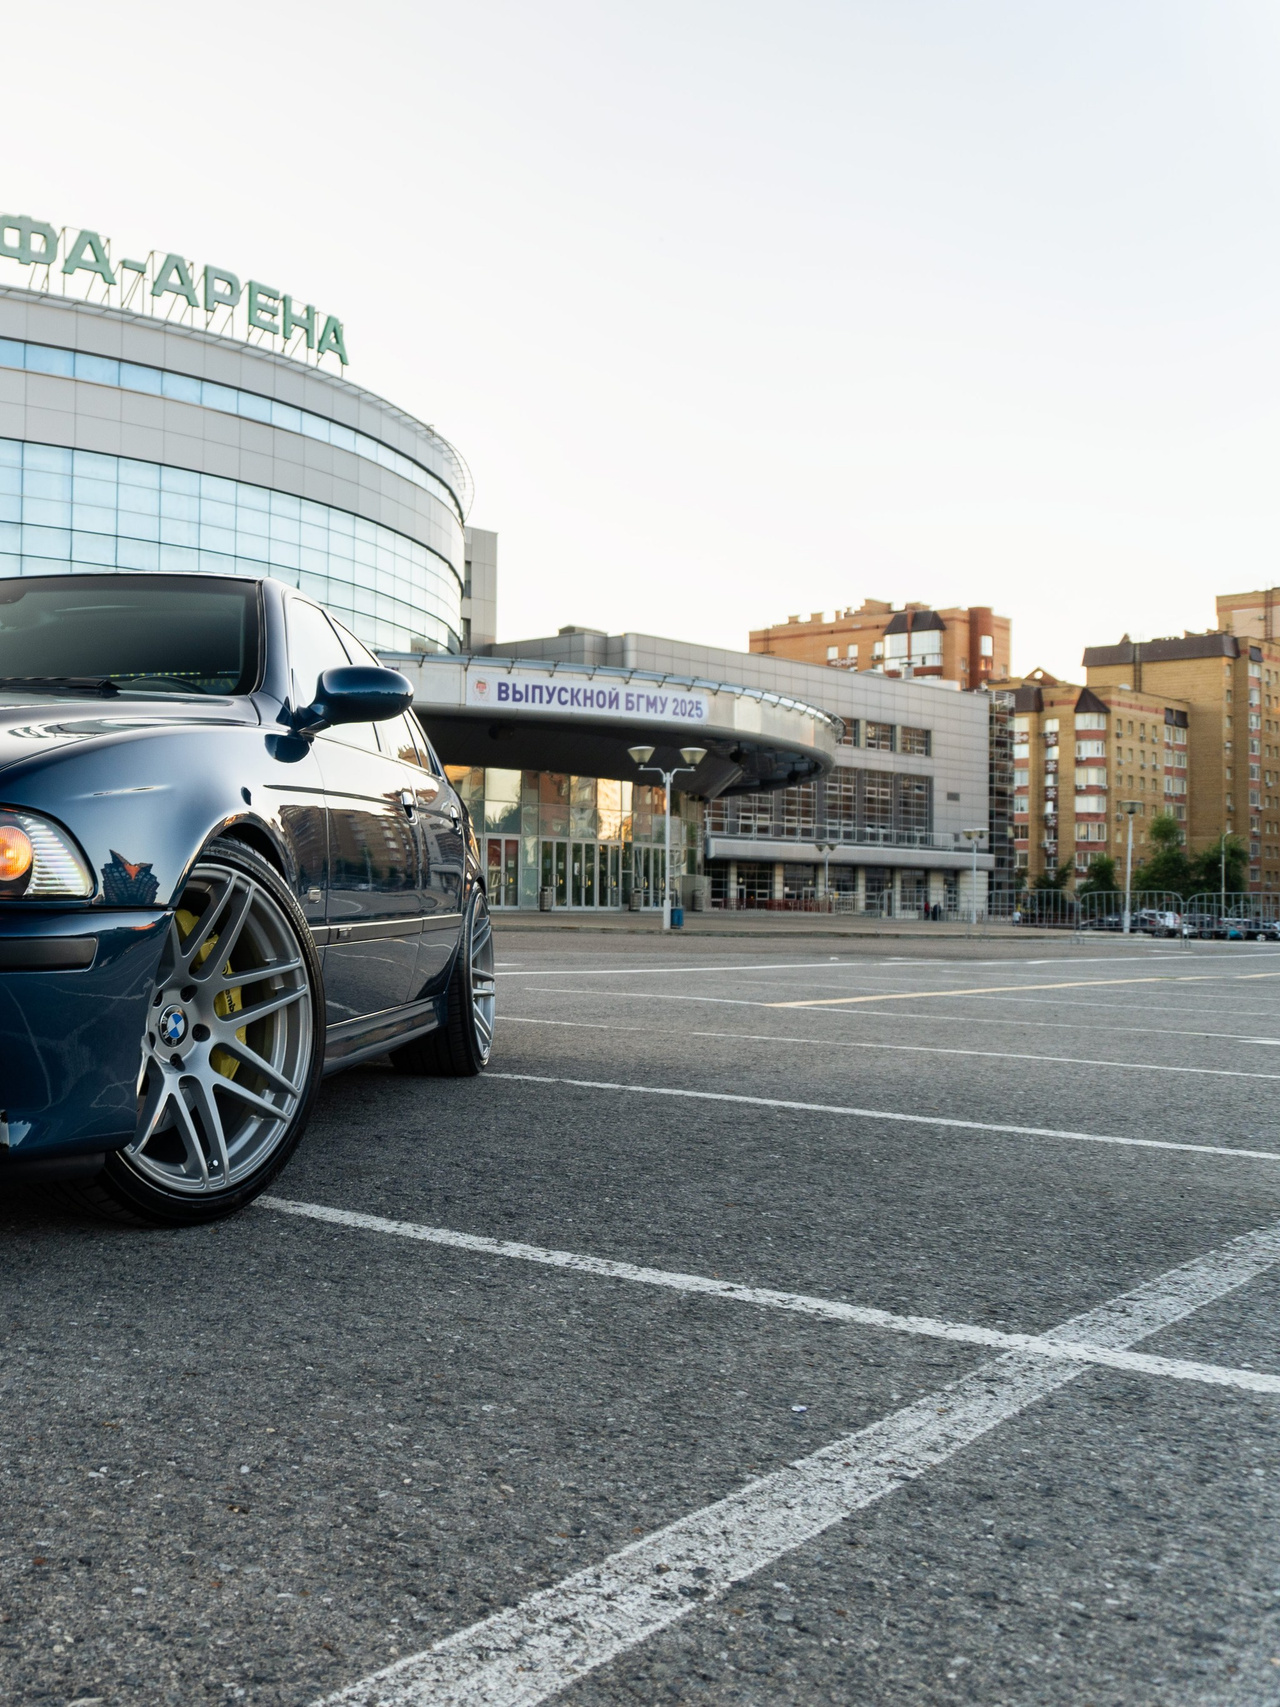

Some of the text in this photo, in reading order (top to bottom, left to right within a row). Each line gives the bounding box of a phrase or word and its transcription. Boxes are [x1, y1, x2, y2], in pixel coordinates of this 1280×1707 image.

[497, 681, 704, 719] ВЫПУСКНОЙ БГМУ 2025
